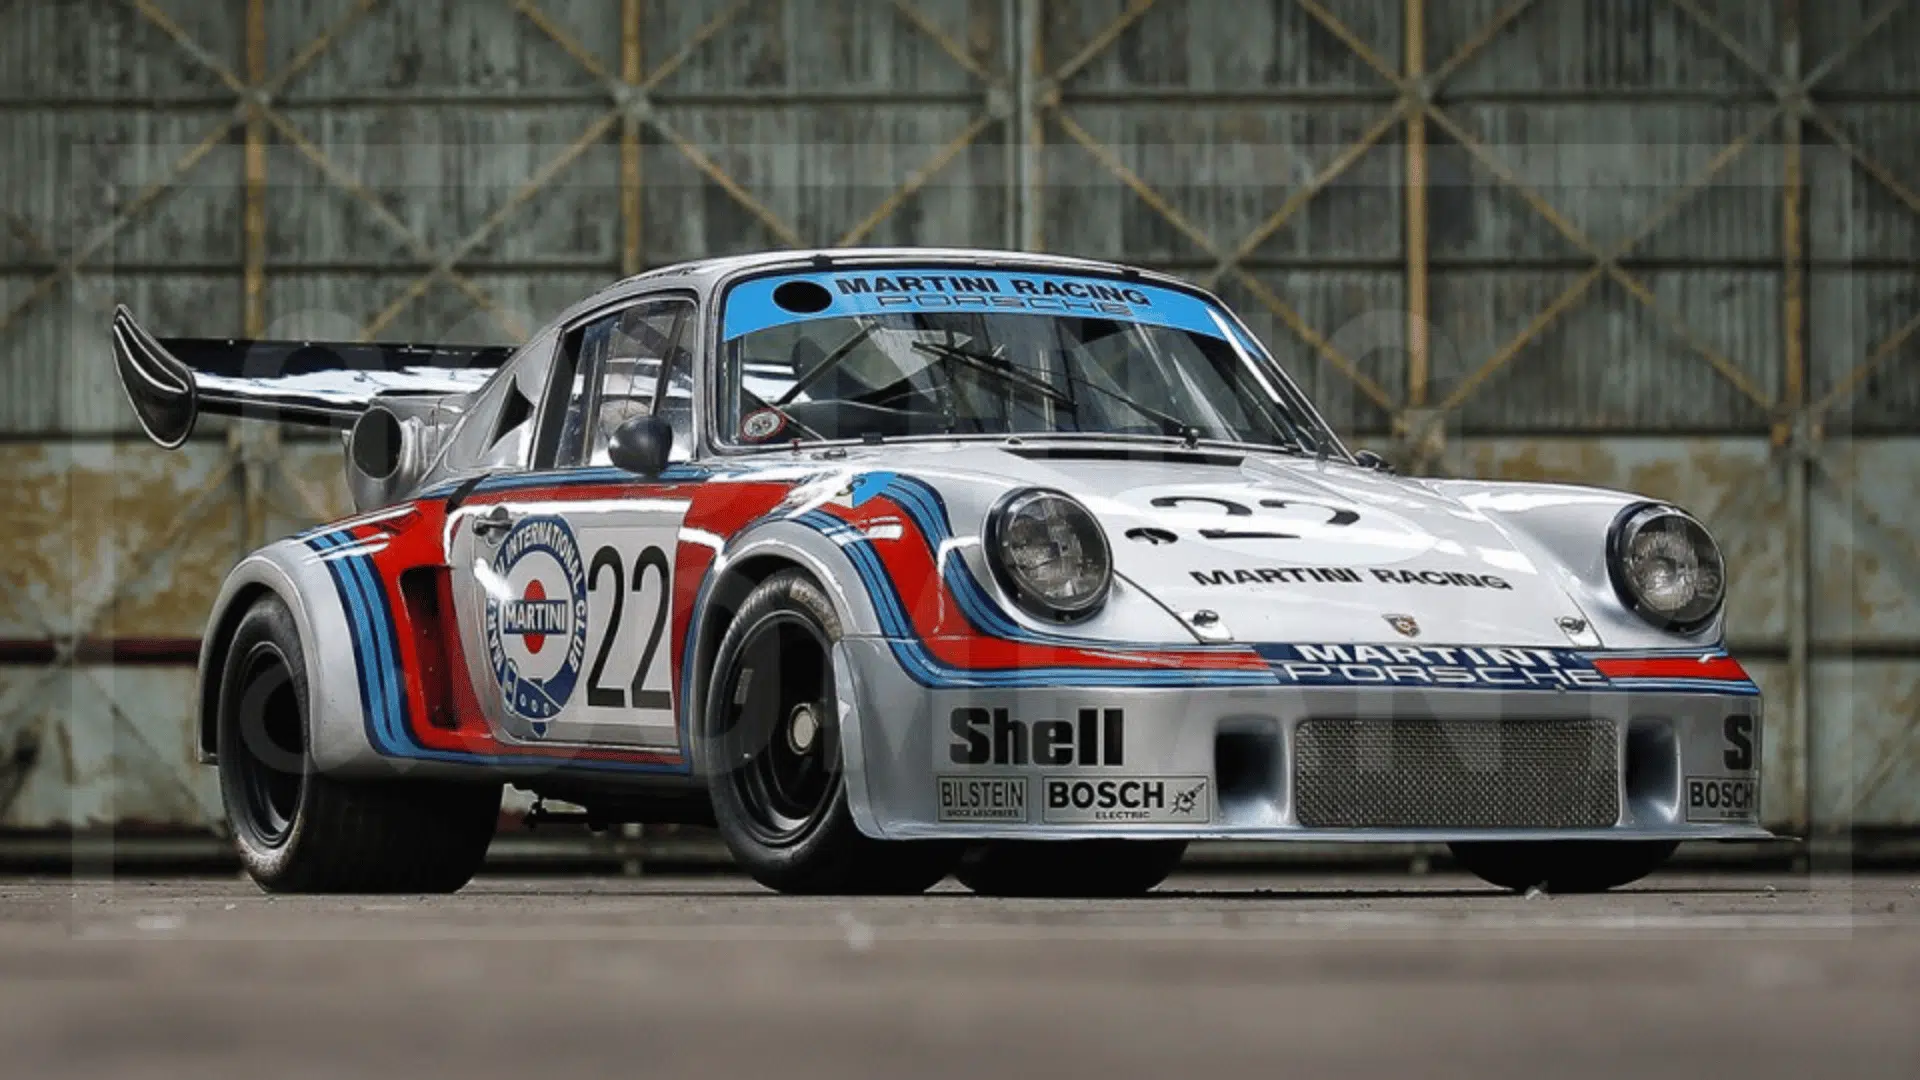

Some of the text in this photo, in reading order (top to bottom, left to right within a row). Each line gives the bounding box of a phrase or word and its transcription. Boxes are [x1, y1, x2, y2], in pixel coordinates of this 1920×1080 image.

[835, 274, 1152, 307] MARTINI RACING
[877, 294, 1134, 317] PORSCHE
[1188, 567, 1513, 590] MARTINI RACING
[506, 521, 587, 673] INTERNATIONAL CLUB
[504, 602, 567, 631] MARTINI
[587, 545, 672, 710] 22
[1293, 644, 1561, 667] MARTINI
[1282, 662, 1611, 687] PORSCHE
[949, 706, 1124, 766] Shell
[1723, 714, 1761, 771] S
[941, 781, 1024, 807] BILSTEIN
[1048, 781, 1164, 808] BOSCH
[1690, 781, 1754, 809] BOSCH
[1095, 811, 1151, 820] ELECTRIC
